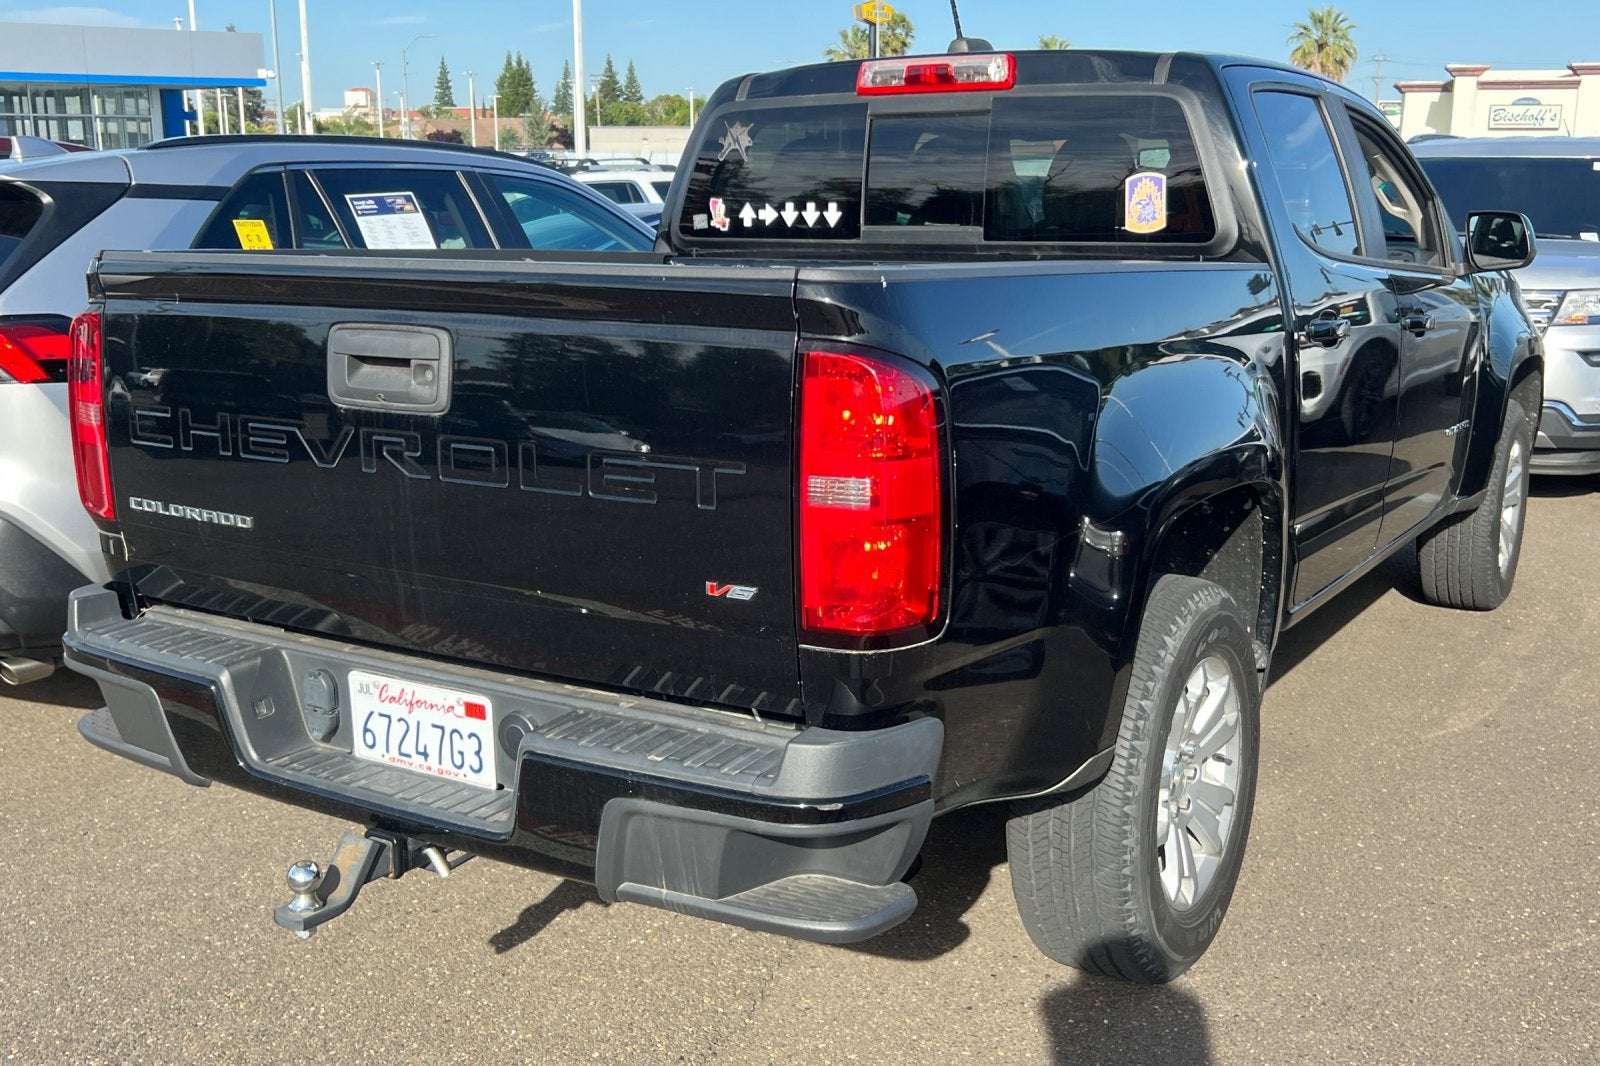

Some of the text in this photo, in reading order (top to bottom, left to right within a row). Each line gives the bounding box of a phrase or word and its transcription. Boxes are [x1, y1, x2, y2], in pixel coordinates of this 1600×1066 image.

[1492, 108, 1557, 127] Bischoff's
[129, 405, 747, 511] CHEVROLET
[129, 496, 254, 530] COLORADO
[705, 580, 759, 601] V6
[357, 682, 373, 696] JUL
[378, 683, 465, 718] California
[362, 710, 484, 774] 67247G3
[388, 756, 460, 778] dmv.ca.gov
